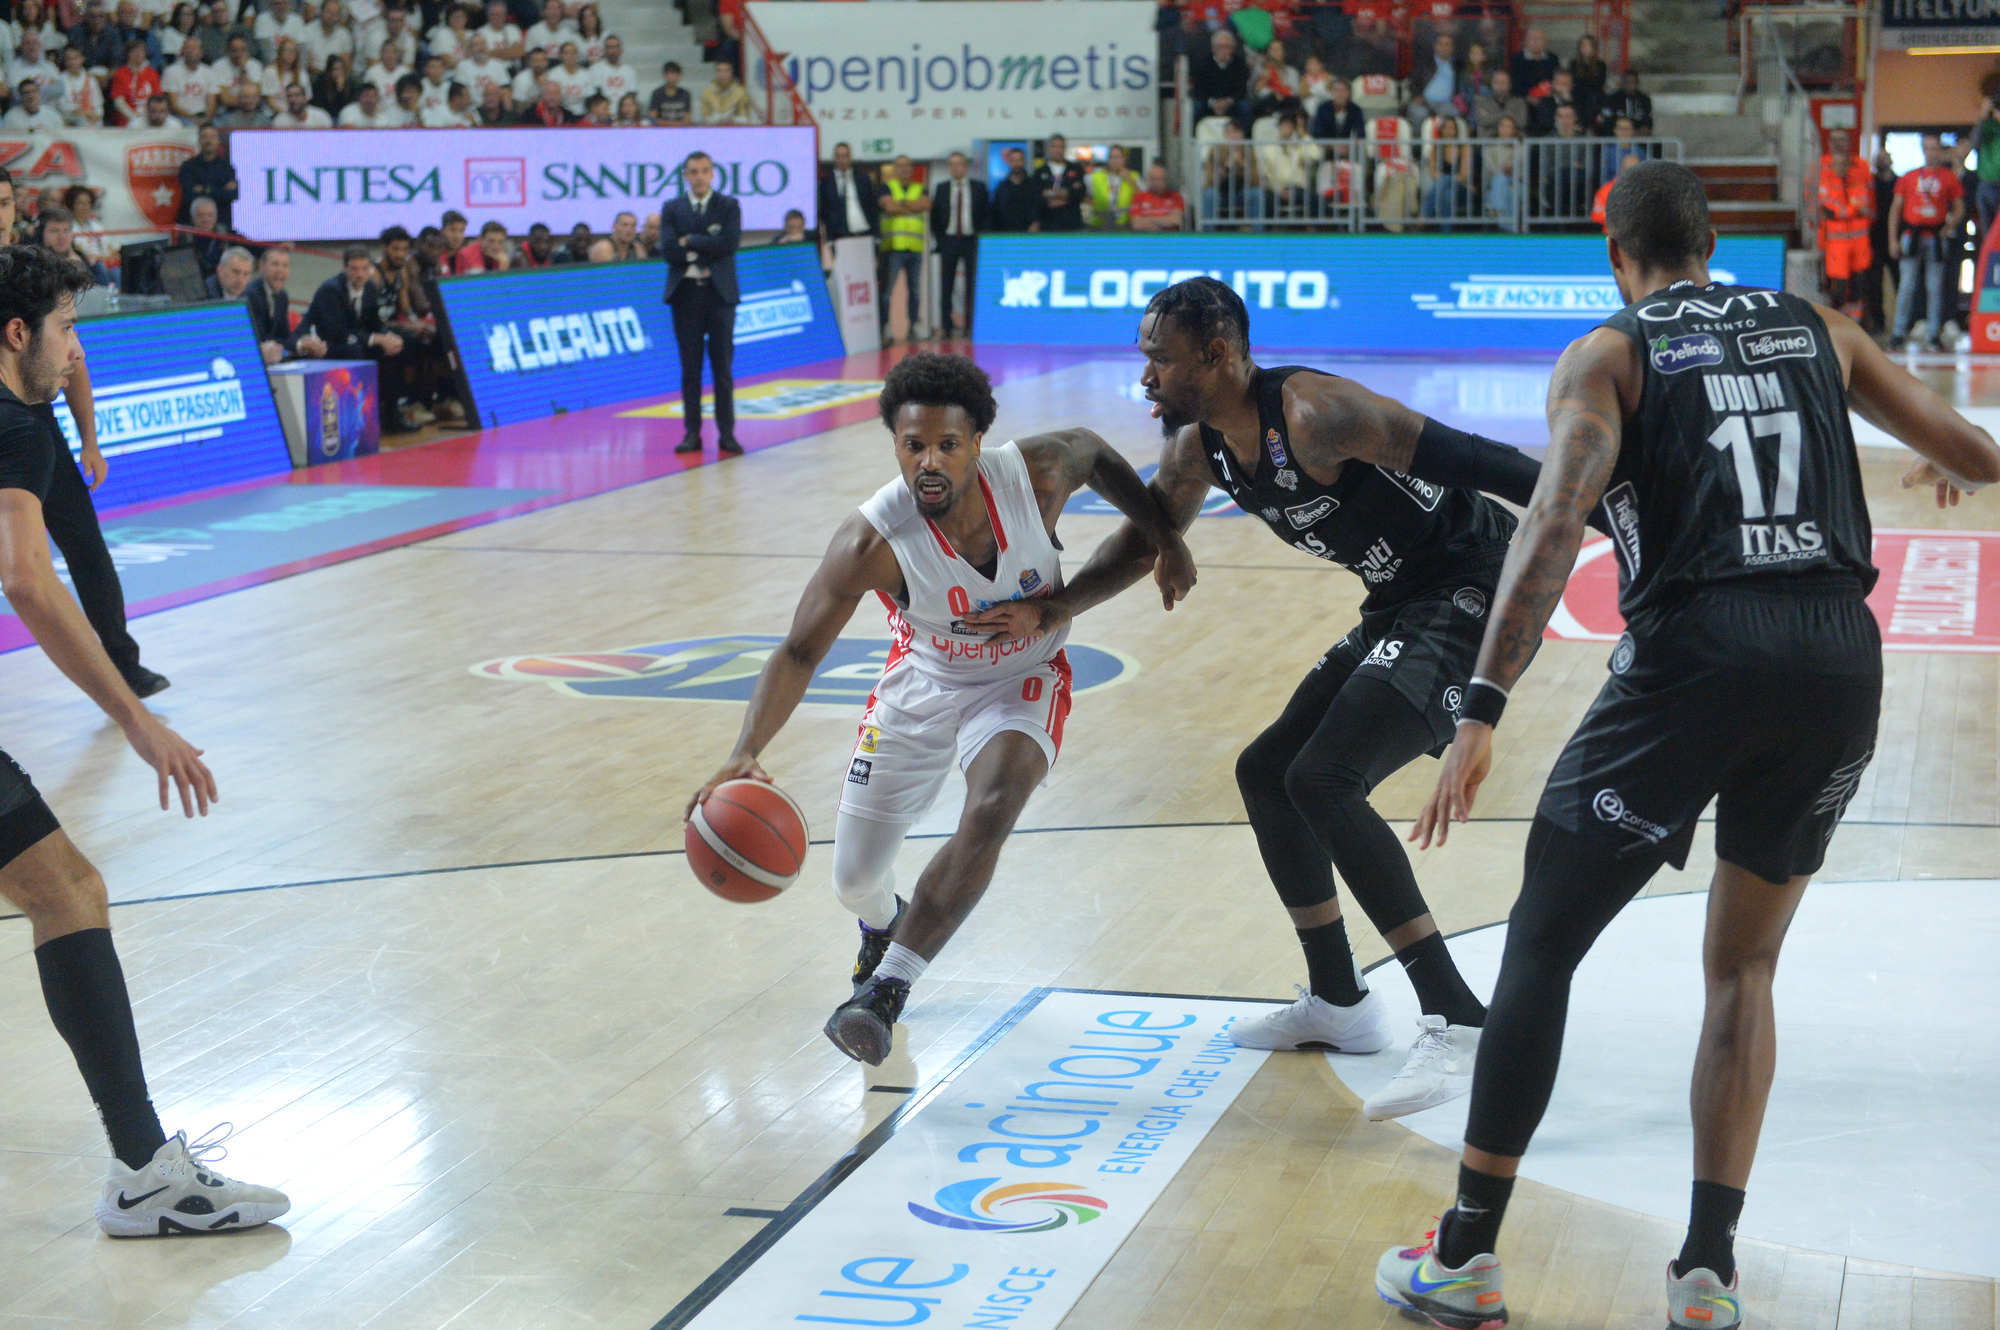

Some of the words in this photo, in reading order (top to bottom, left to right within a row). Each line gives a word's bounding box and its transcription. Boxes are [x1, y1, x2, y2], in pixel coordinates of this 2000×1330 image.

[911, 108, 967, 120] PER
[987, 107, 1012, 119] IL
[1034, 107, 1152, 119] LAVORO
[264, 165, 443, 204] INTESA
[1467, 288, 1498, 305] WE
[1503, 288, 1567, 305] MOVE
[1573, 287, 1620, 305] YOU
[1637, 290, 1779, 321] CAVIT
[508, 305, 646, 370] LOCAUTO
[1691, 319, 1757, 332] TRENTO
[94, 405, 126, 436] OVE
[125, 398, 174, 429] YOUR
[175, 387, 242, 425] PASSION
[1707, 411, 1801, 519] 17
[1740, 521, 1826, 556] ITAS
[947, 586, 969, 617] 0
[1022, 676, 1043, 702] 0
[957, 1010, 1198, 1169] acinque
[1097, 1104, 1193, 1175] ENERGIA
[1164, 1068, 1221, 1099] CHE
